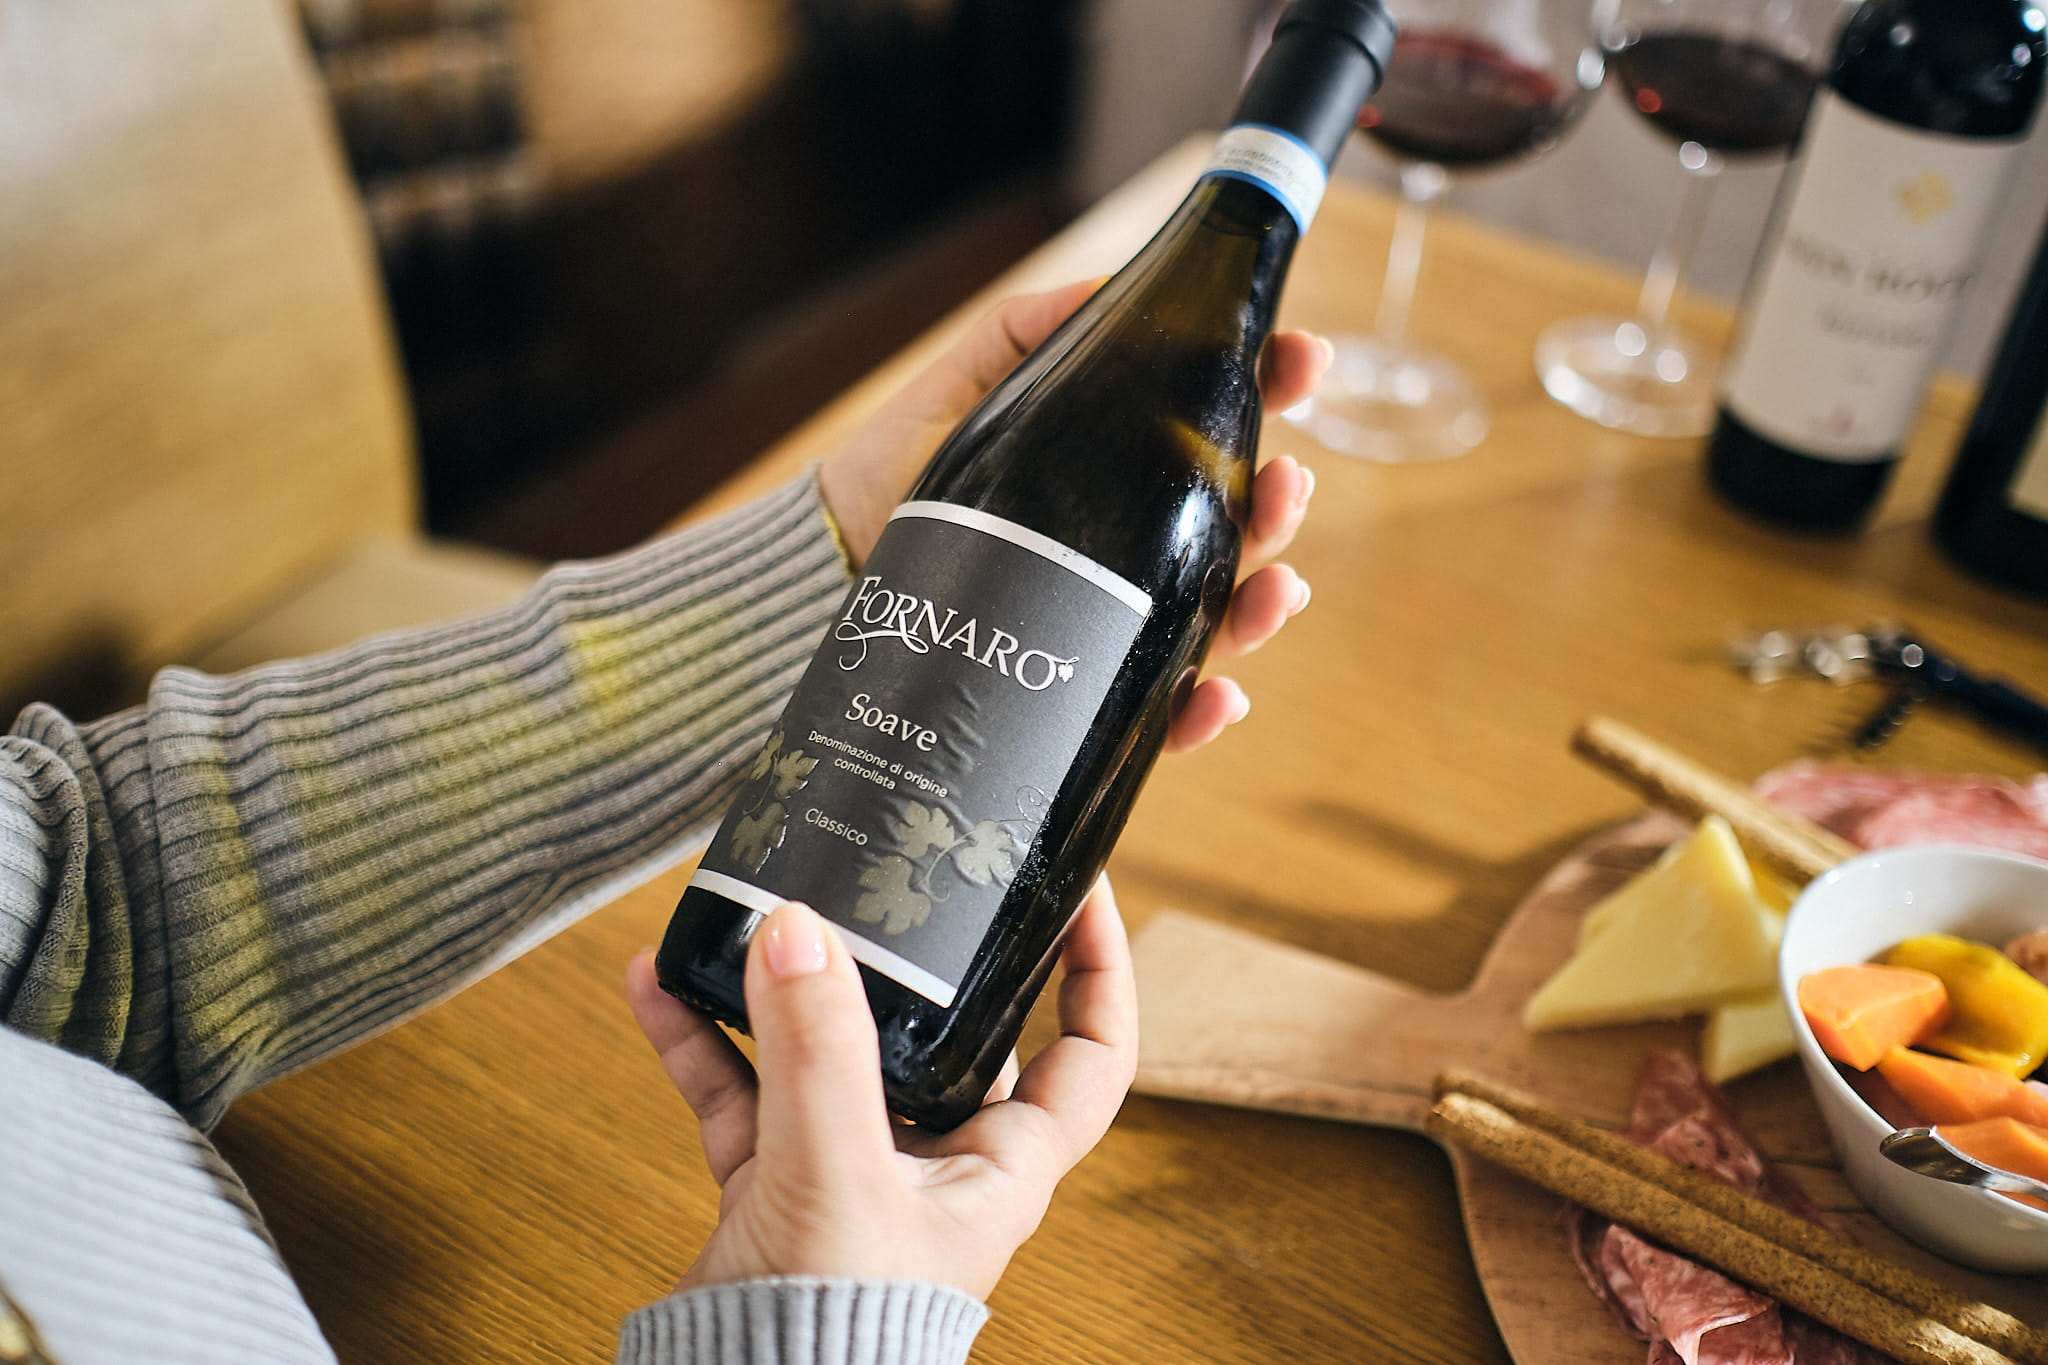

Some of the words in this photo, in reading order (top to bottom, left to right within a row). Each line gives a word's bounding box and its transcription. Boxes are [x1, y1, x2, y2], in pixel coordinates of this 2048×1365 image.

[836, 576, 1078, 691] FORNARO
[845, 693, 938, 751] Soave
[808, 730, 889, 769] Denominazione
[889, 763, 904, 776] di
[904, 771, 948, 798] origine
[834, 757, 896, 790] controllata
[805, 808, 868, 845] Classico
